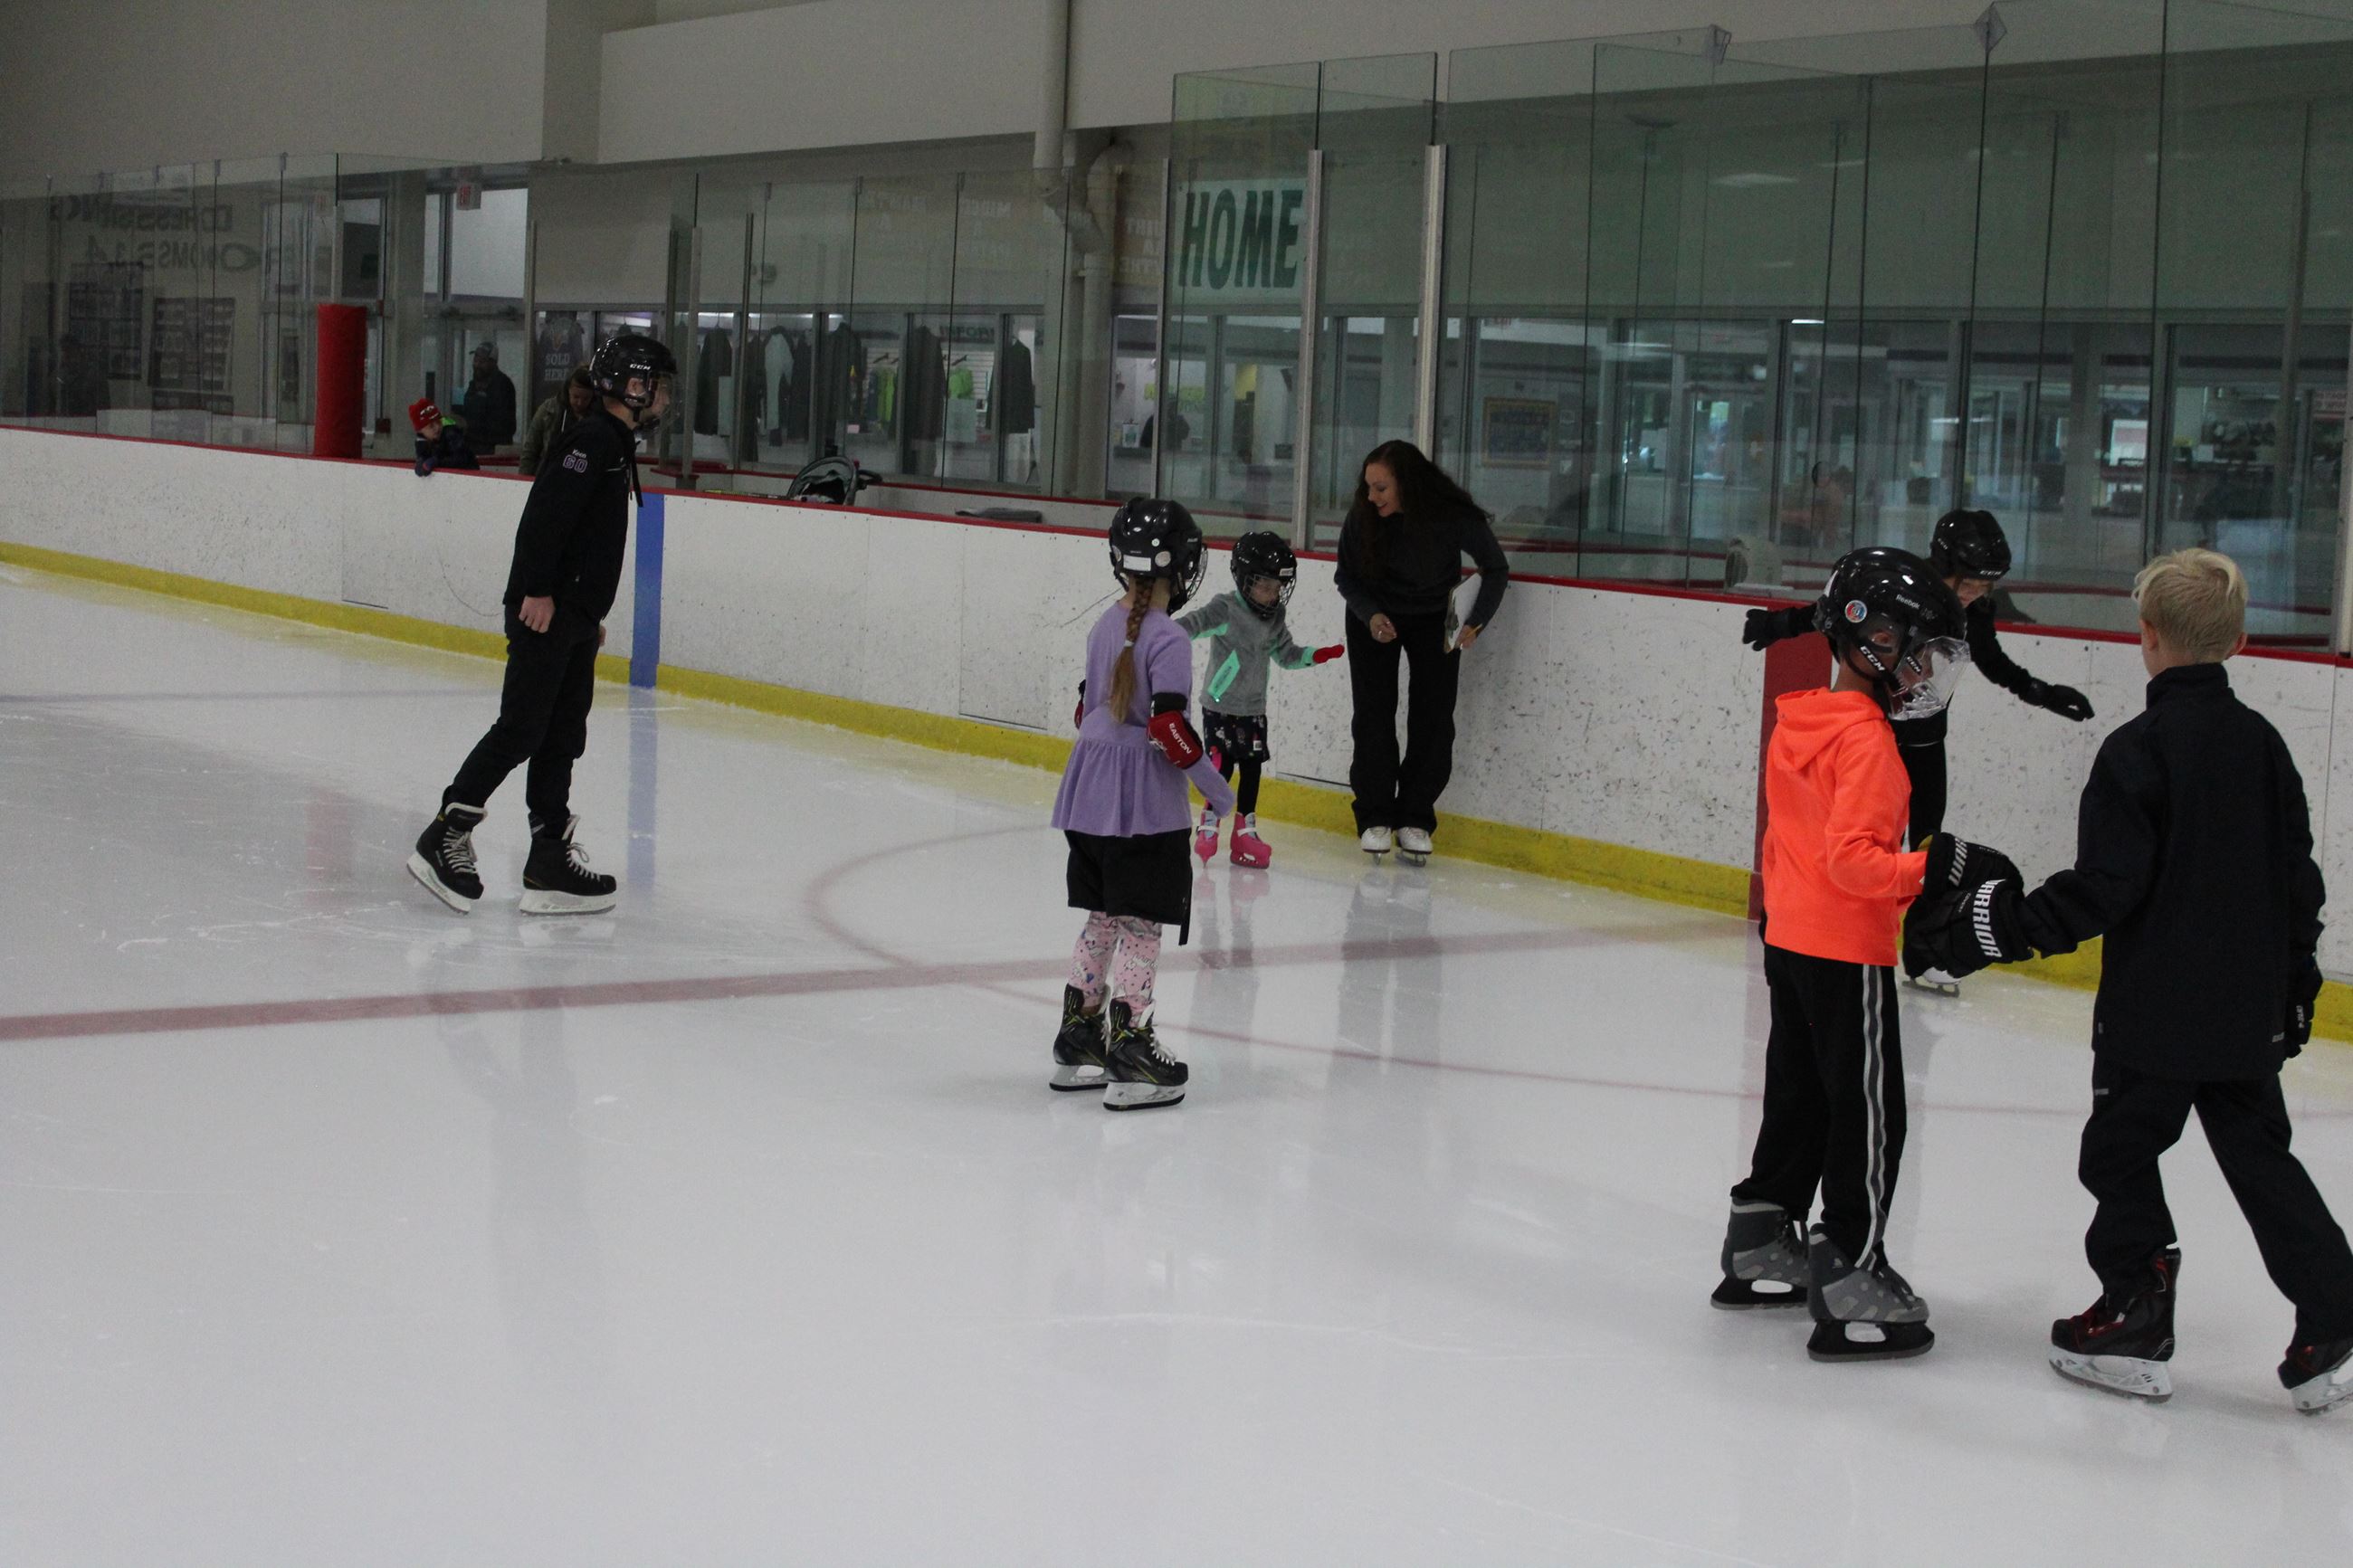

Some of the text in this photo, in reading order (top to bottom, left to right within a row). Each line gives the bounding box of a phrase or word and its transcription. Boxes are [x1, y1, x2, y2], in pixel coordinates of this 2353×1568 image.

[1178, 188, 1303, 290] HOME
[545, 353, 570, 366] SOLD
[563, 454, 588, 473] 60
[1895, 594, 1920, 610] Reebok
[1860, 645, 1886, 671] CCM
[1906, 656, 1922, 673] CCM
[1168, 722, 1193, 755] EASTON
